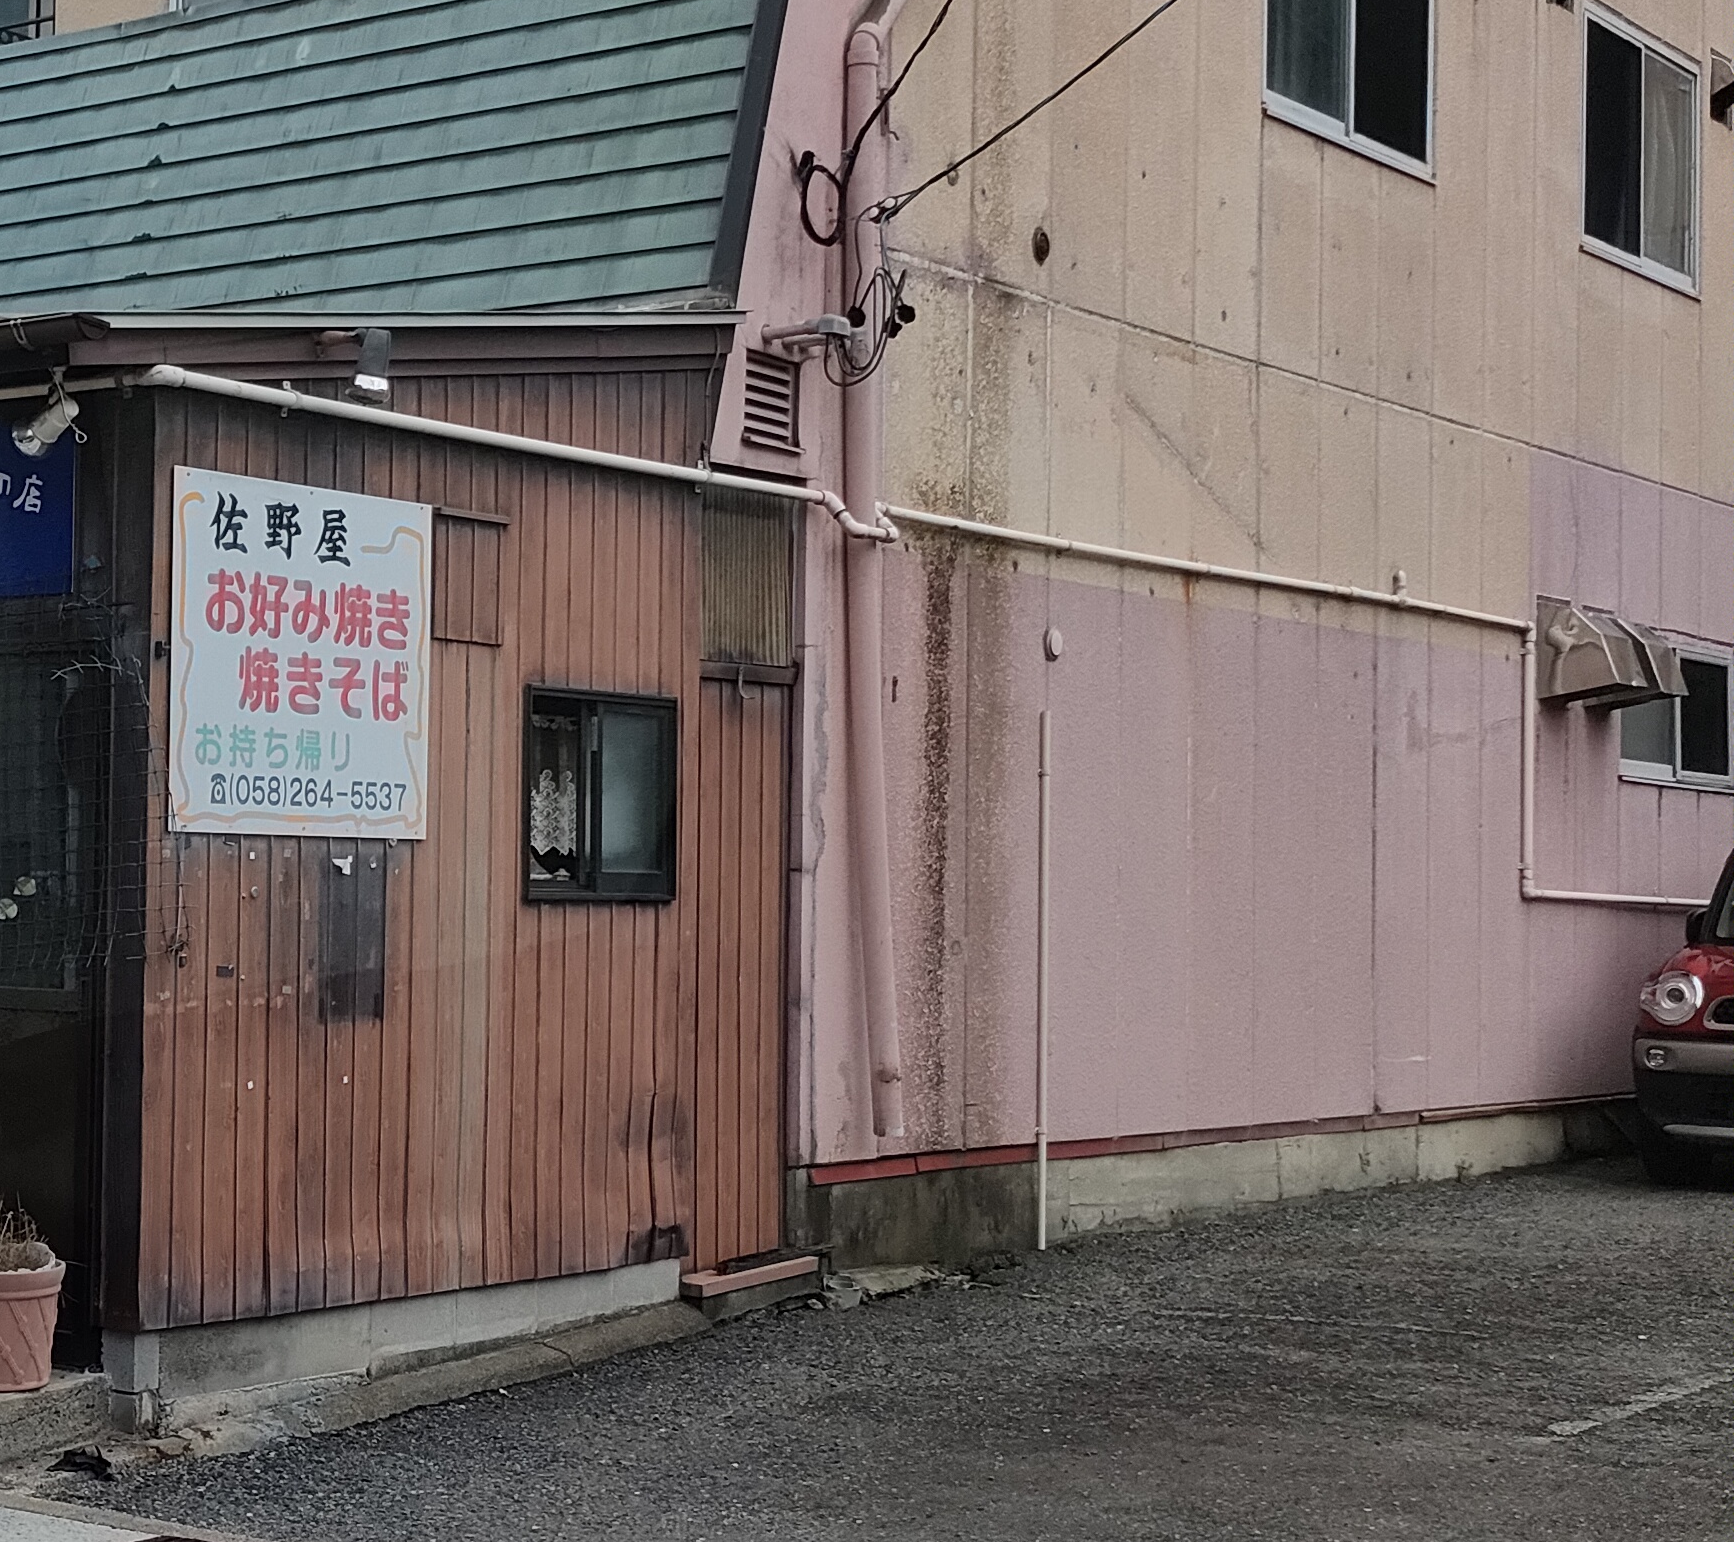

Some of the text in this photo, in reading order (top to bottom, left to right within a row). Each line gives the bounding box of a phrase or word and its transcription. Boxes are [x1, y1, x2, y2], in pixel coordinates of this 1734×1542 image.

[209, 490, 351, 567] 佐野屋
[205, 568, 411, 651] お好み焼き
[238, 645, 409, 721] 焼きそば
[194, 722, 351, 772] お持ち帰り
[229, 773, 407, 811] (058)264-5537
